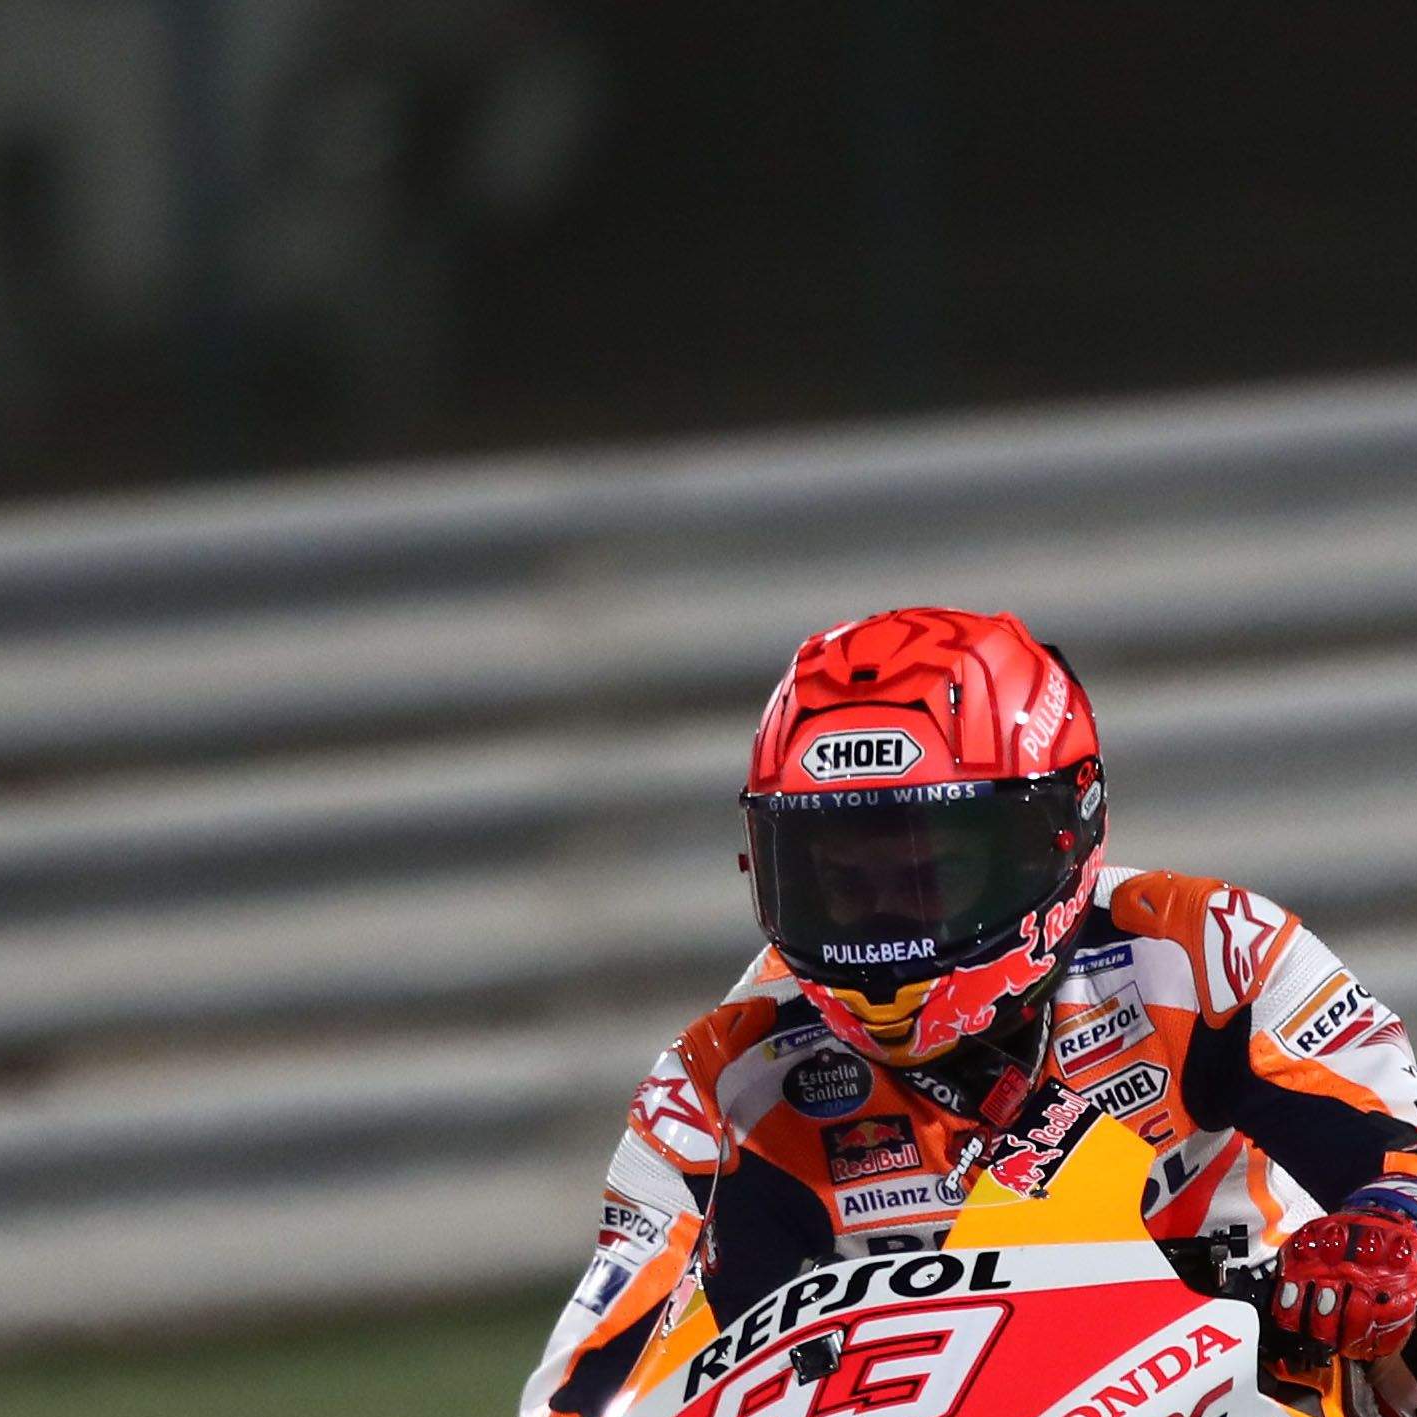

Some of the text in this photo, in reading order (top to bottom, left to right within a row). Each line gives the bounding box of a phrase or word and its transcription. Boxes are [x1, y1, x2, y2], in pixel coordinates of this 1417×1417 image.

[816, 738, 904, 772] SHOEI
[768, 783, 977, 811] GIVES YOU WINGS
[821, 937, 937, 966] PULL&BEAR
[1060, 1004, 1141, 1059] REPSOL
[798, 1062, 859, 1087] Estrella
[1093, 1069, 1158, 1113] HOEI
[802, 1080, 859, 1104] Galicia
[944, 1136, 984, 1193] Puig
[843, 1186, 931, 1217] Allianz
[603, 1205, 659, 1245] EPSOL
[682, 1251, 1014, 1403] REPSOL
